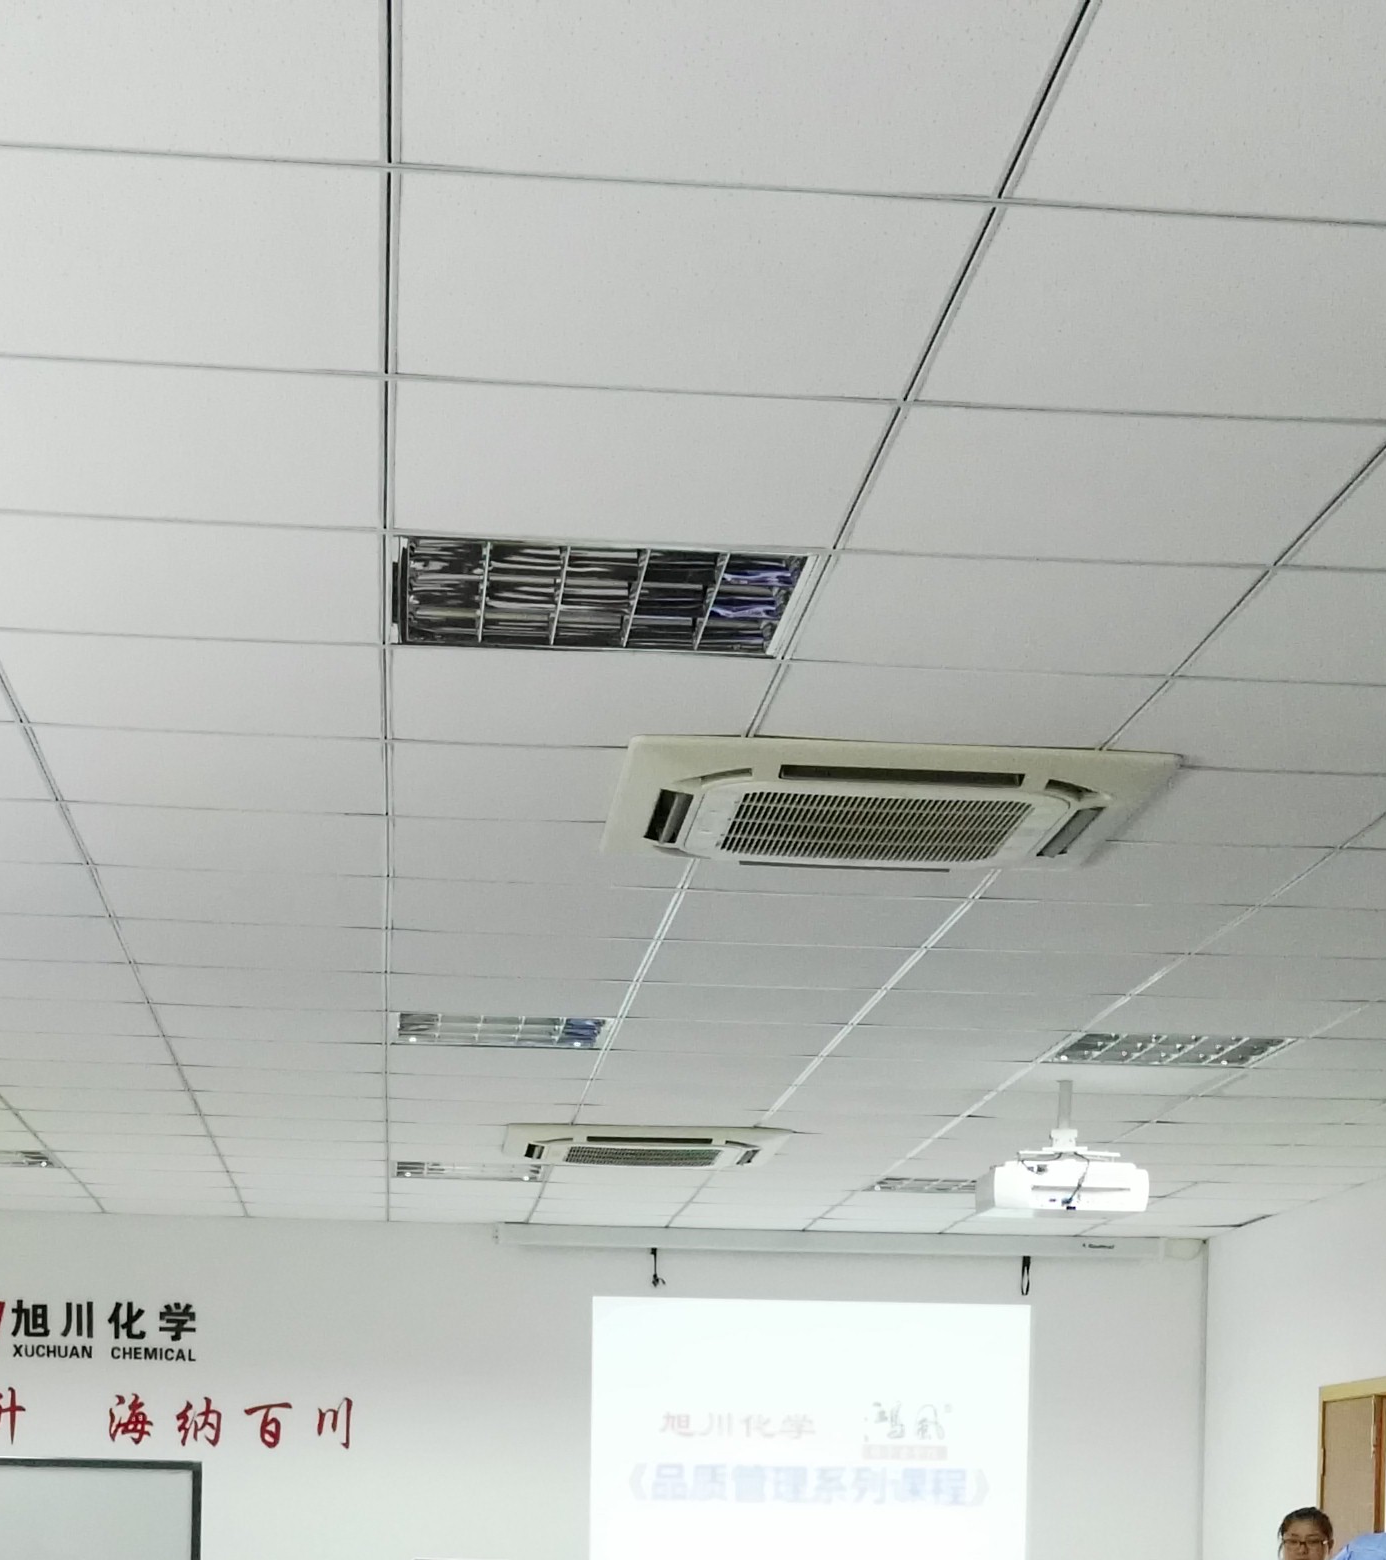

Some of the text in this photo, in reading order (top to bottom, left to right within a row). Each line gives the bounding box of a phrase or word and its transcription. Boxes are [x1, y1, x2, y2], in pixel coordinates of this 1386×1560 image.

[11, 1299, 197, 1341] 旭川化学
[13, 1343, 197, 1362] XUCHUAN CHEMICAL
[108, 1393, 354, 1450] 海纳百川
[658, 1410, 817, 1440] 旭川化学
